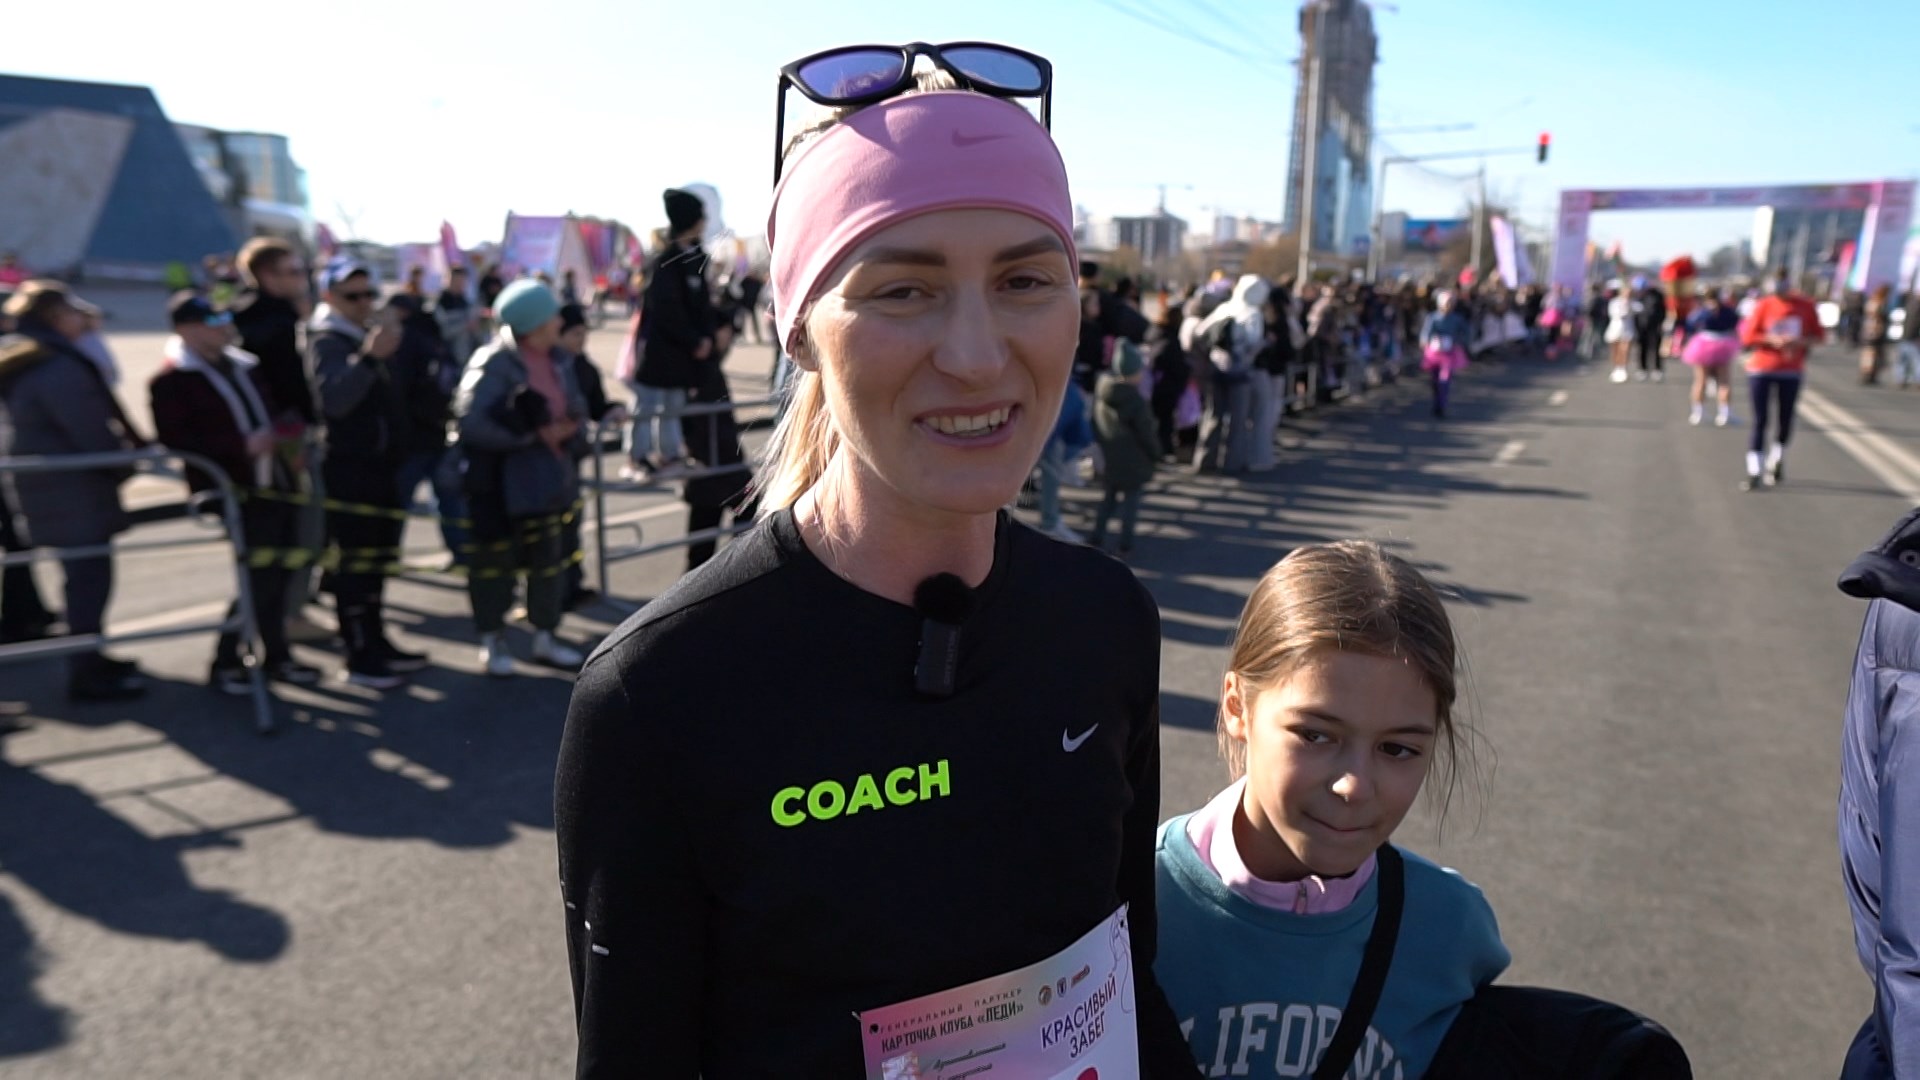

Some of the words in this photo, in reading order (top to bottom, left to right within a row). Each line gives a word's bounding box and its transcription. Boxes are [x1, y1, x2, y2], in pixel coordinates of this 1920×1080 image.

[771, 759, 950, 827] COACH
[974, 987, 1022, 1007] ПАРТНЕР
[1042, 972, 1117, 1048] КРАСИВЫЙ
[882, 1028, 937, 1053] КАРТОЧКА
[940, 1015, 974, 1037] КЛУБА
[1070, 1011, 1105, 1058] ЗАБЕГ
